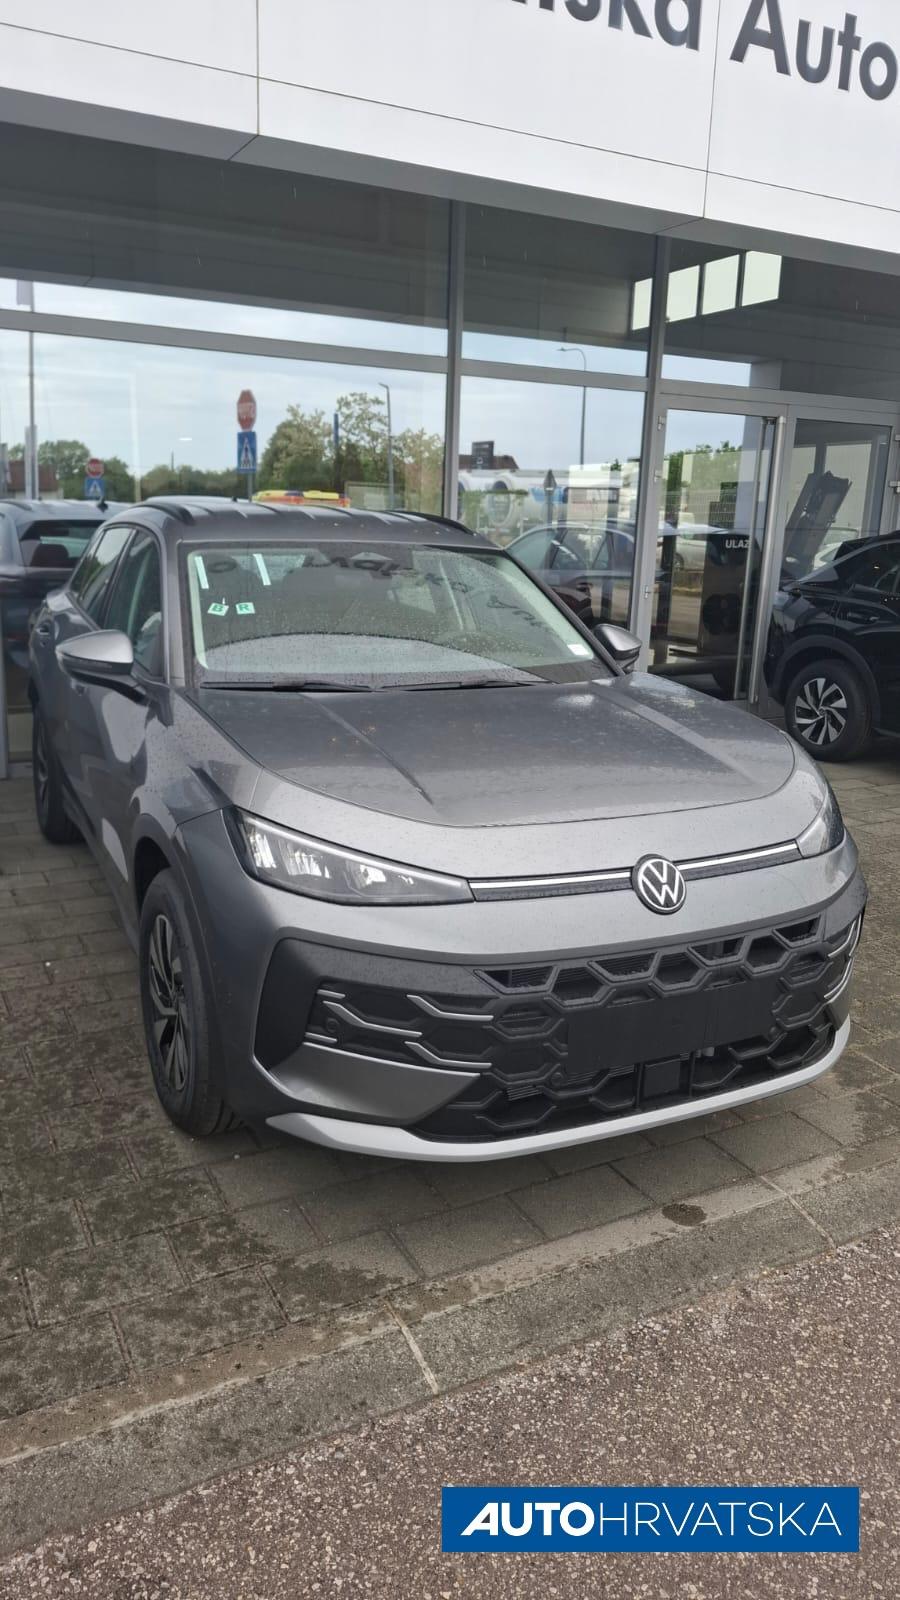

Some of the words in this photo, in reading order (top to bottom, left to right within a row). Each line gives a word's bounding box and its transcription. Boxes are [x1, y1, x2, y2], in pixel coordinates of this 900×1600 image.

[729, 0, 898, 101] Auto
[725, 539, 751, 549] ULAZ
[238, 603, 251, 612] R
